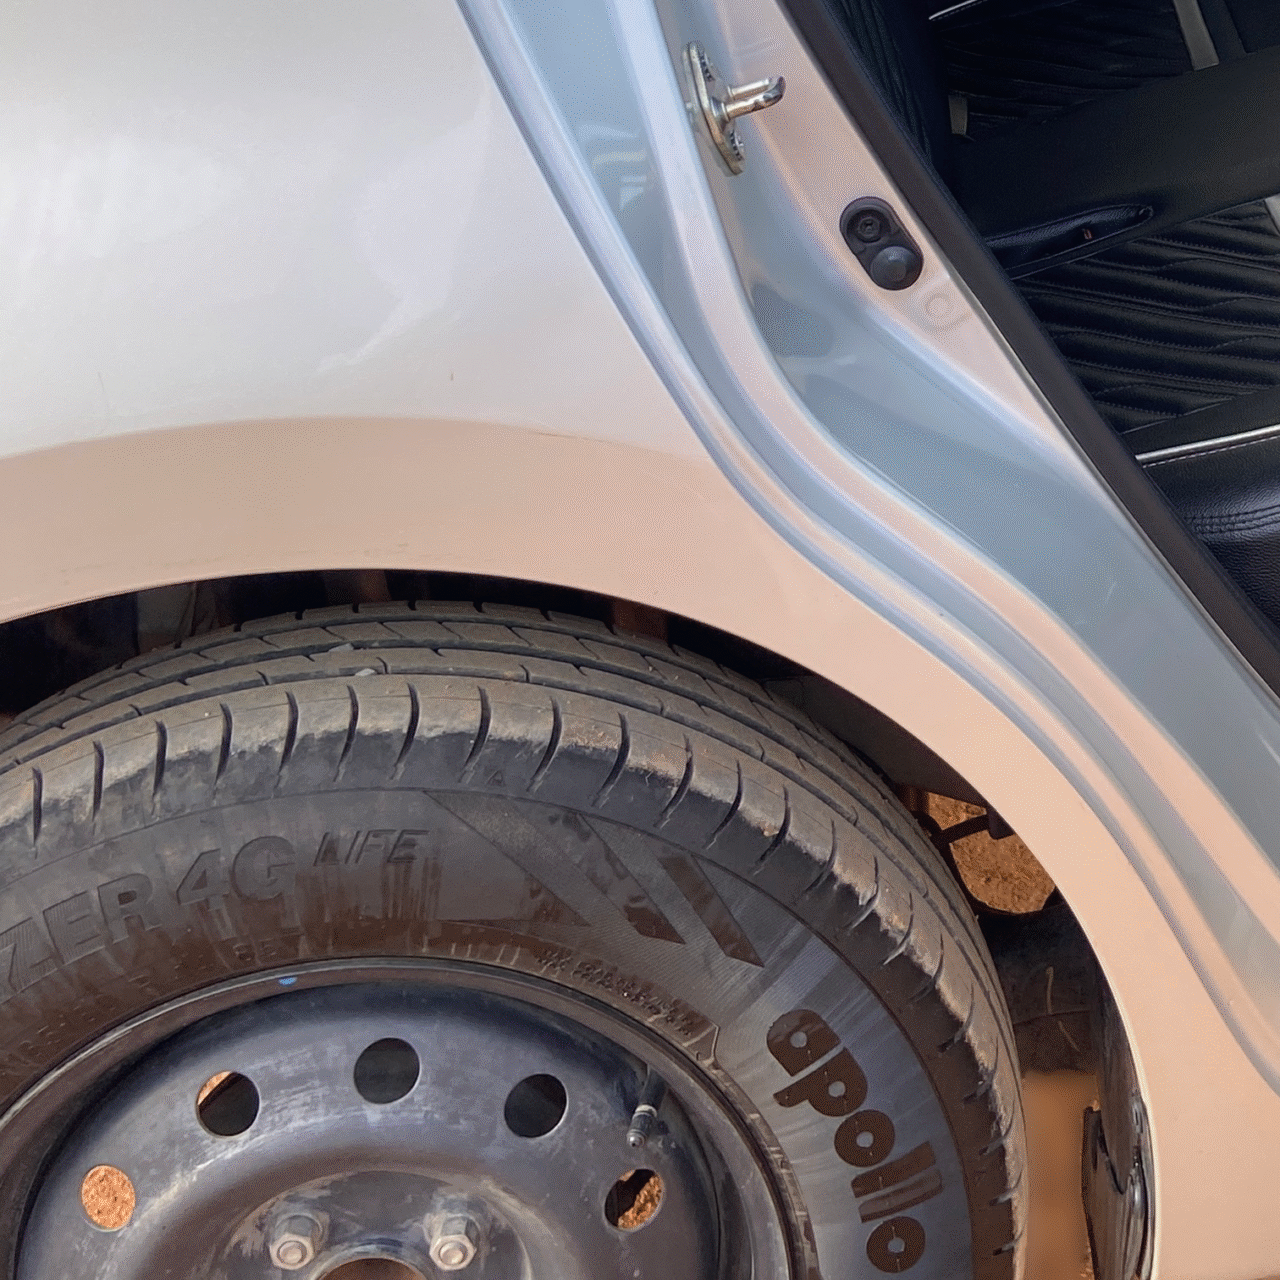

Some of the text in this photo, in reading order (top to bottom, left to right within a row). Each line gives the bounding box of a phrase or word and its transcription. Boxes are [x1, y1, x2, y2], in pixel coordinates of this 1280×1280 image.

[176, 835, 297, 907] 4G
[314, 829, 430, 867] LIFE
[766, 1009, 943, 1273] apollo
